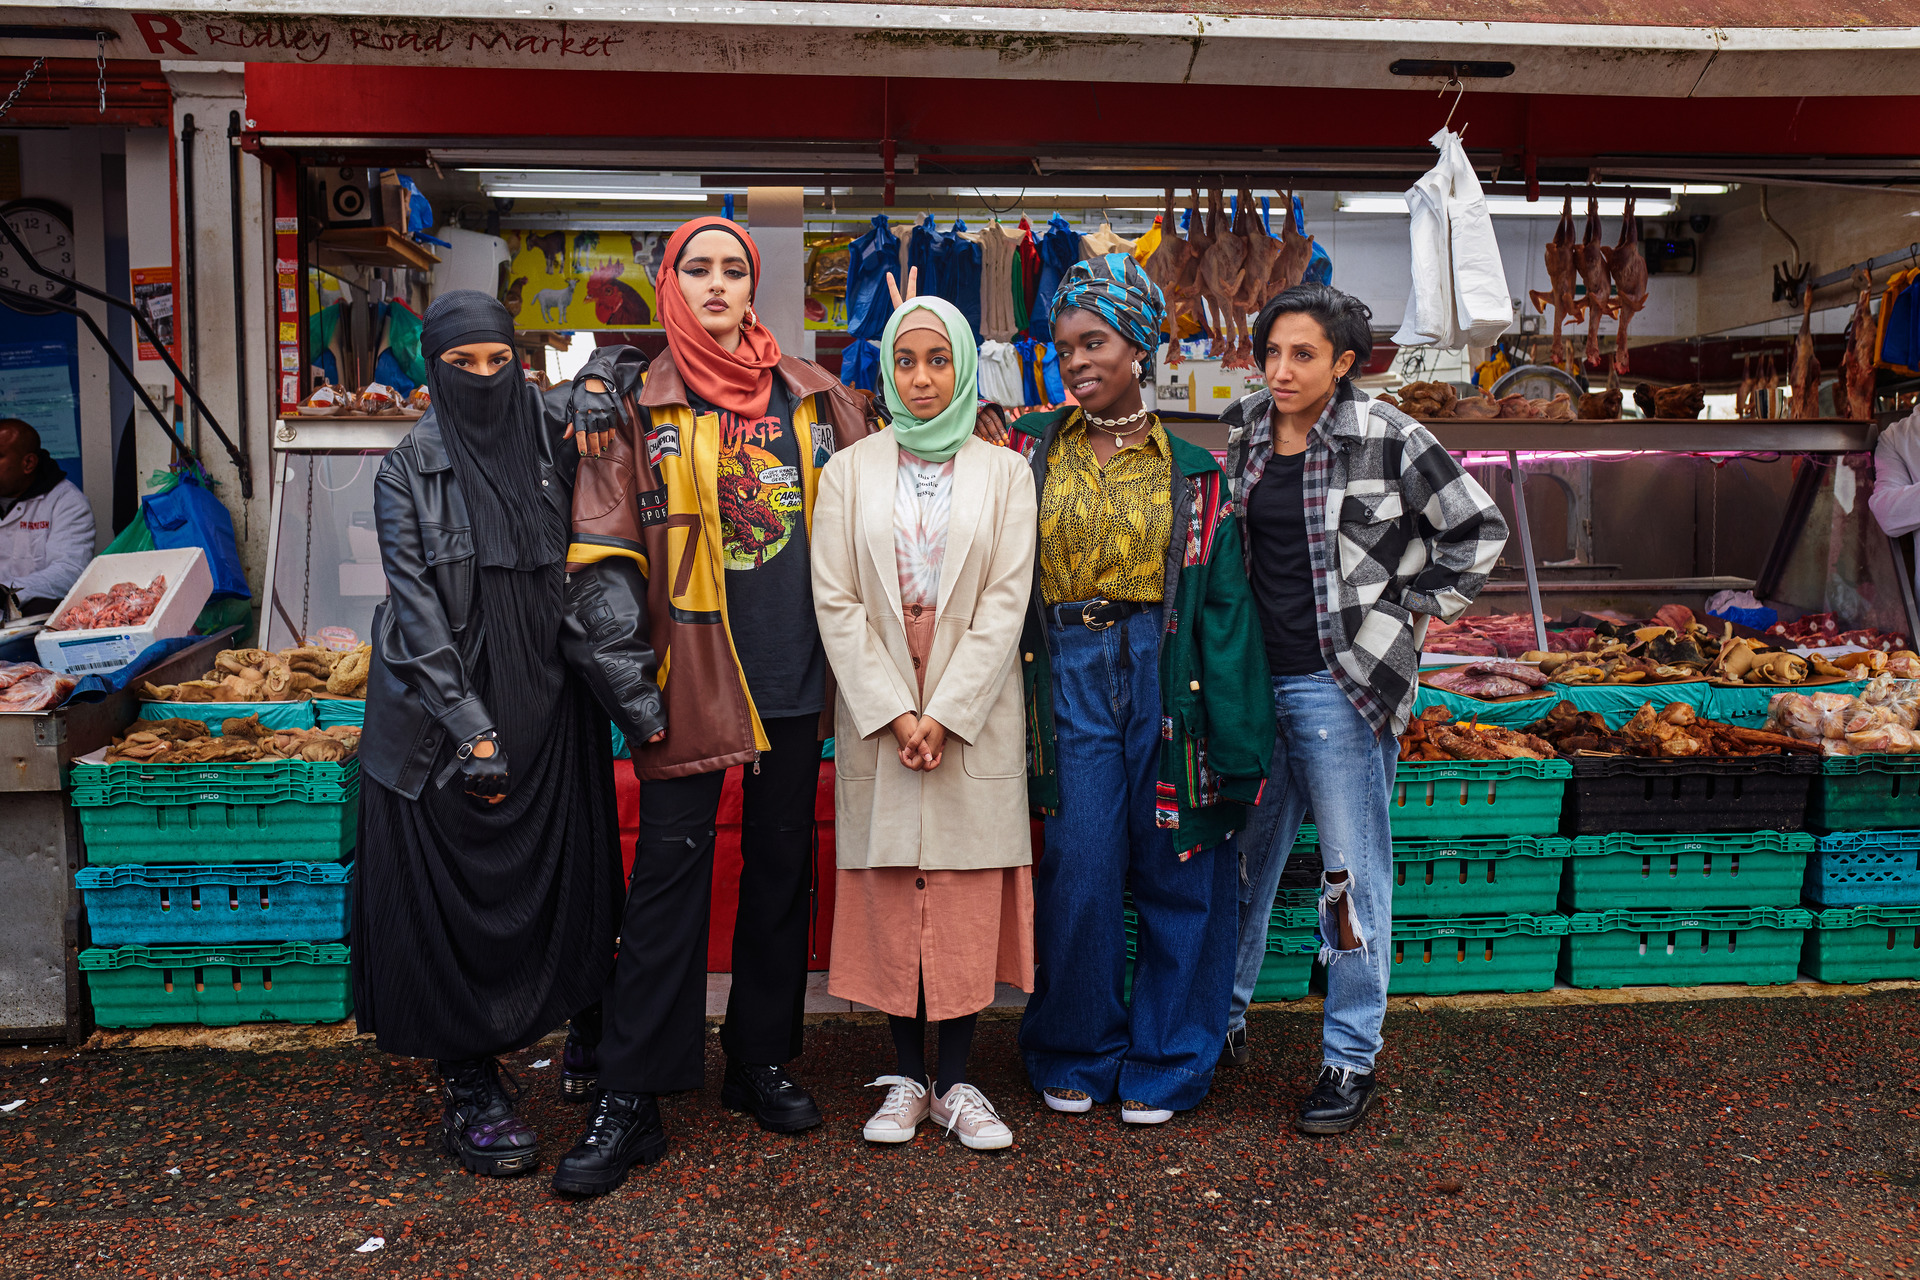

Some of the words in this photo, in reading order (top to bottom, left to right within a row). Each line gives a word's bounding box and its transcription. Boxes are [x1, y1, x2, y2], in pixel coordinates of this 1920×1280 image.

[205, 23, 330, 62] Ridley
[352, 25, 451, 54] Road
[468, 25, 625, 57] Market
[24, 218, 39, 229] 12
[45, 223, 51, 234] 1
[56, 235, 66, 246] 2
[62, 252, 71, 263] 3
[719, 411, 783, 452] NAGE
